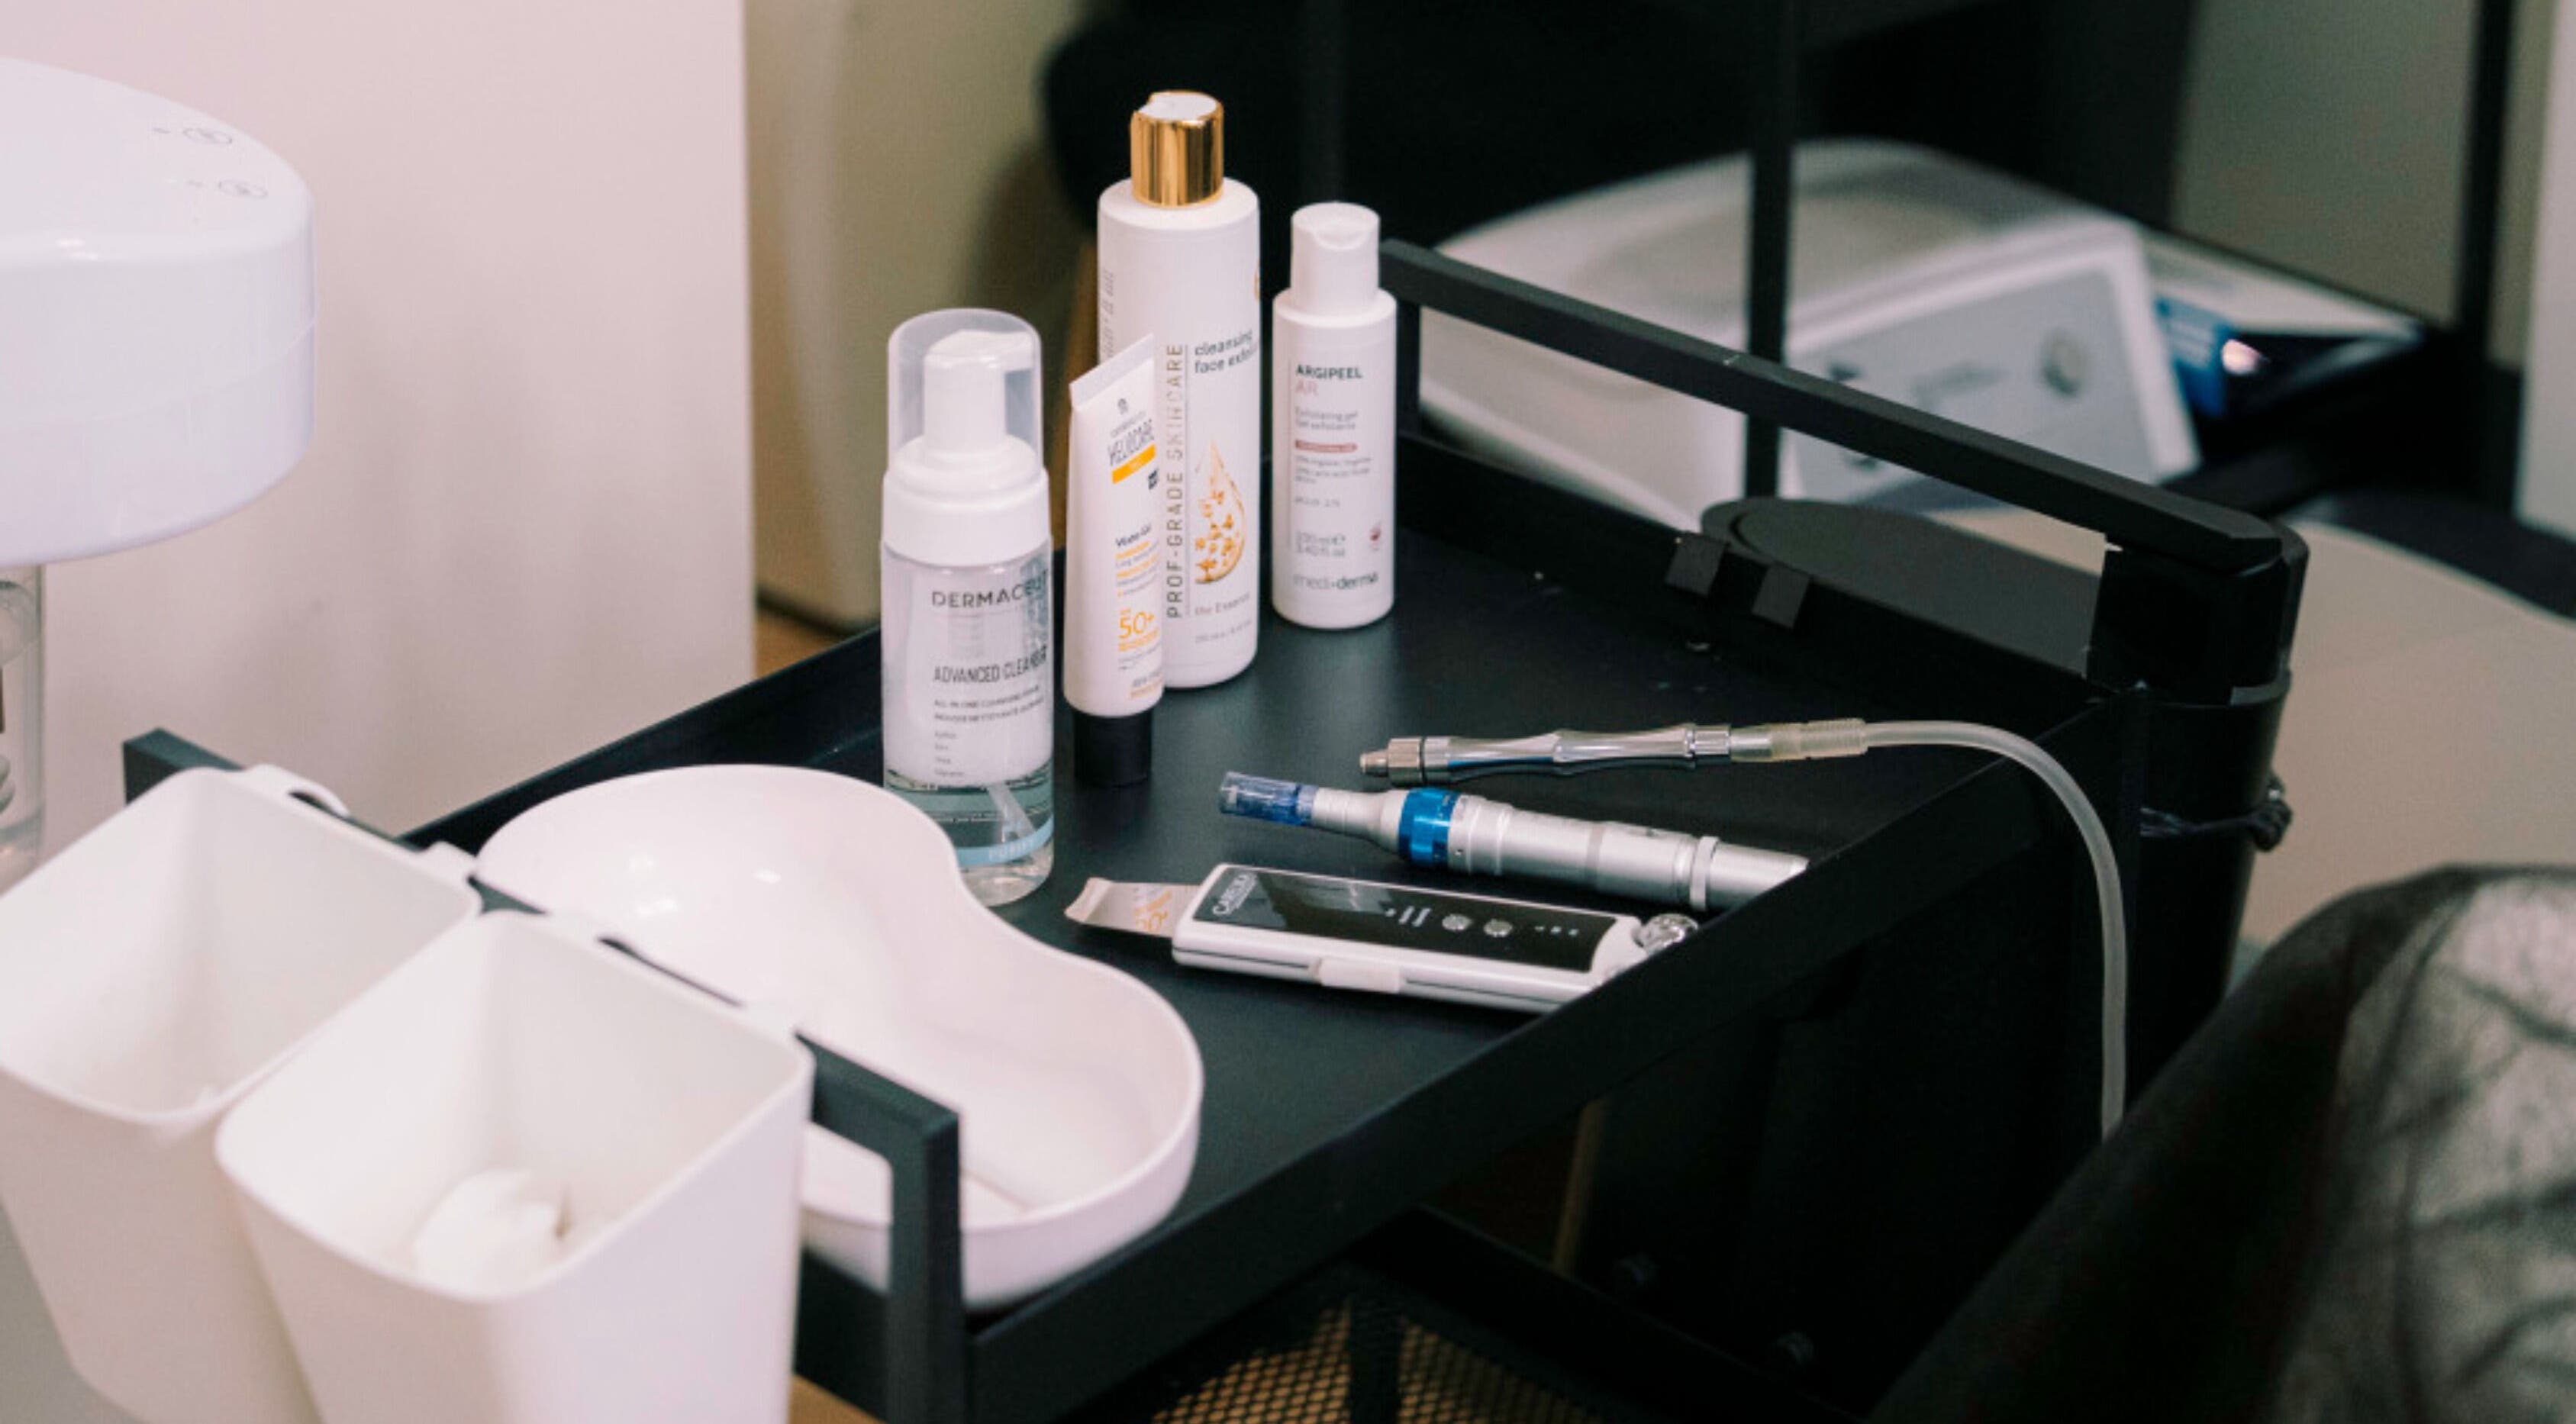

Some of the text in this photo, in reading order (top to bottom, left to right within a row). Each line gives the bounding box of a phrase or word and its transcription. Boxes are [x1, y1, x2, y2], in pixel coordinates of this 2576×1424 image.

[1195, 360, 1224, 373] face
[1297, 364, 1364, 379] ARGIPEEL
[1297, 380, 1318, 396] AR
[1166, 344, 1184, 618] PROF-GRADE SKINCARE
[1118, 611, 1155, 640] 50+
[934, 665, 1001, 683] ADVANCED
